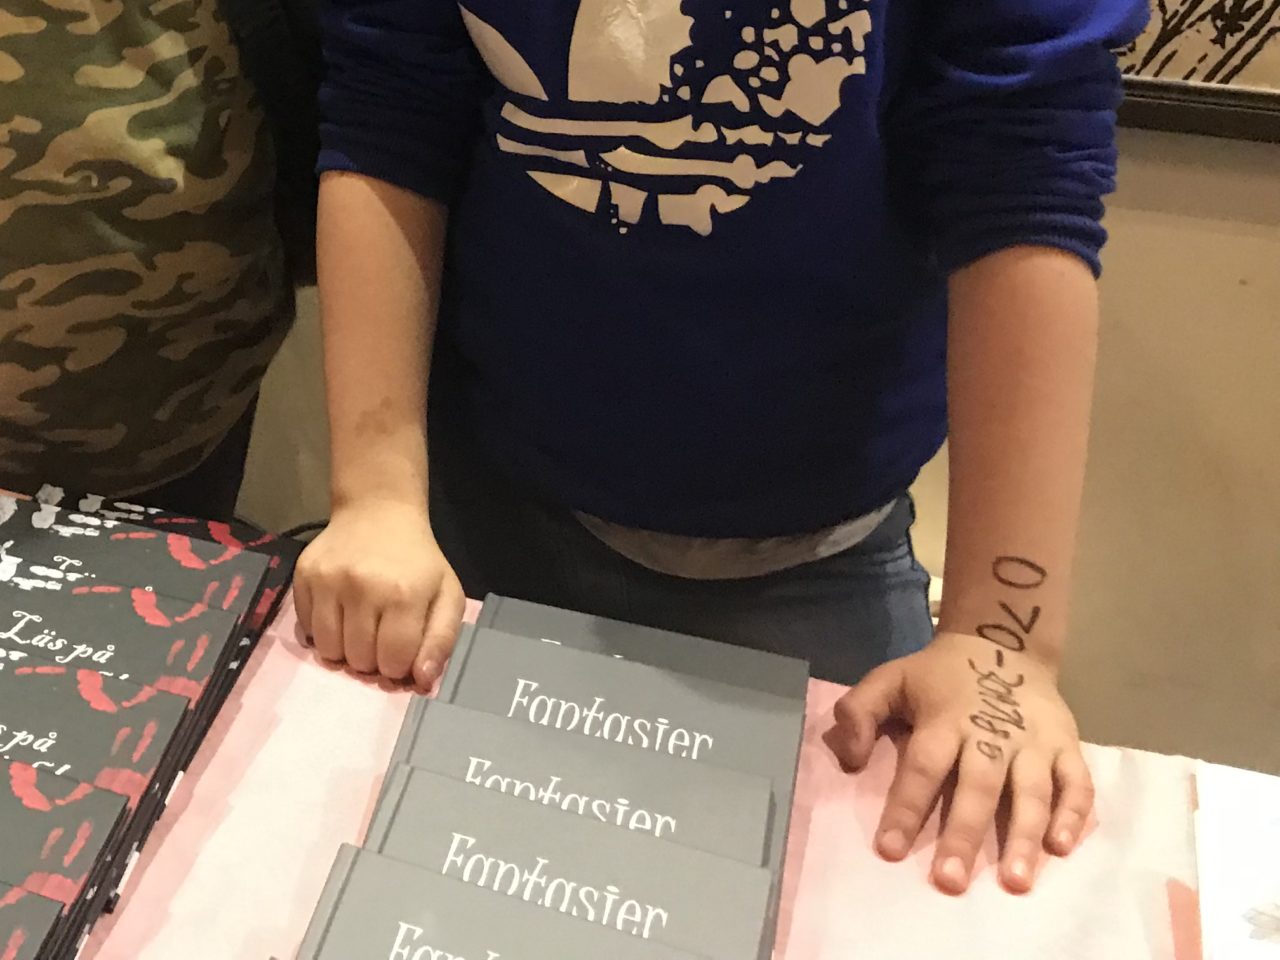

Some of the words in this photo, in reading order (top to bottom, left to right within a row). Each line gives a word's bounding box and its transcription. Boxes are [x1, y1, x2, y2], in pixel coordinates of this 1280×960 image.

[55, 643, 115, 664] på
[507, 678, 713, 760] Fantasier
[442, 832, 668, 939] Fantasier
